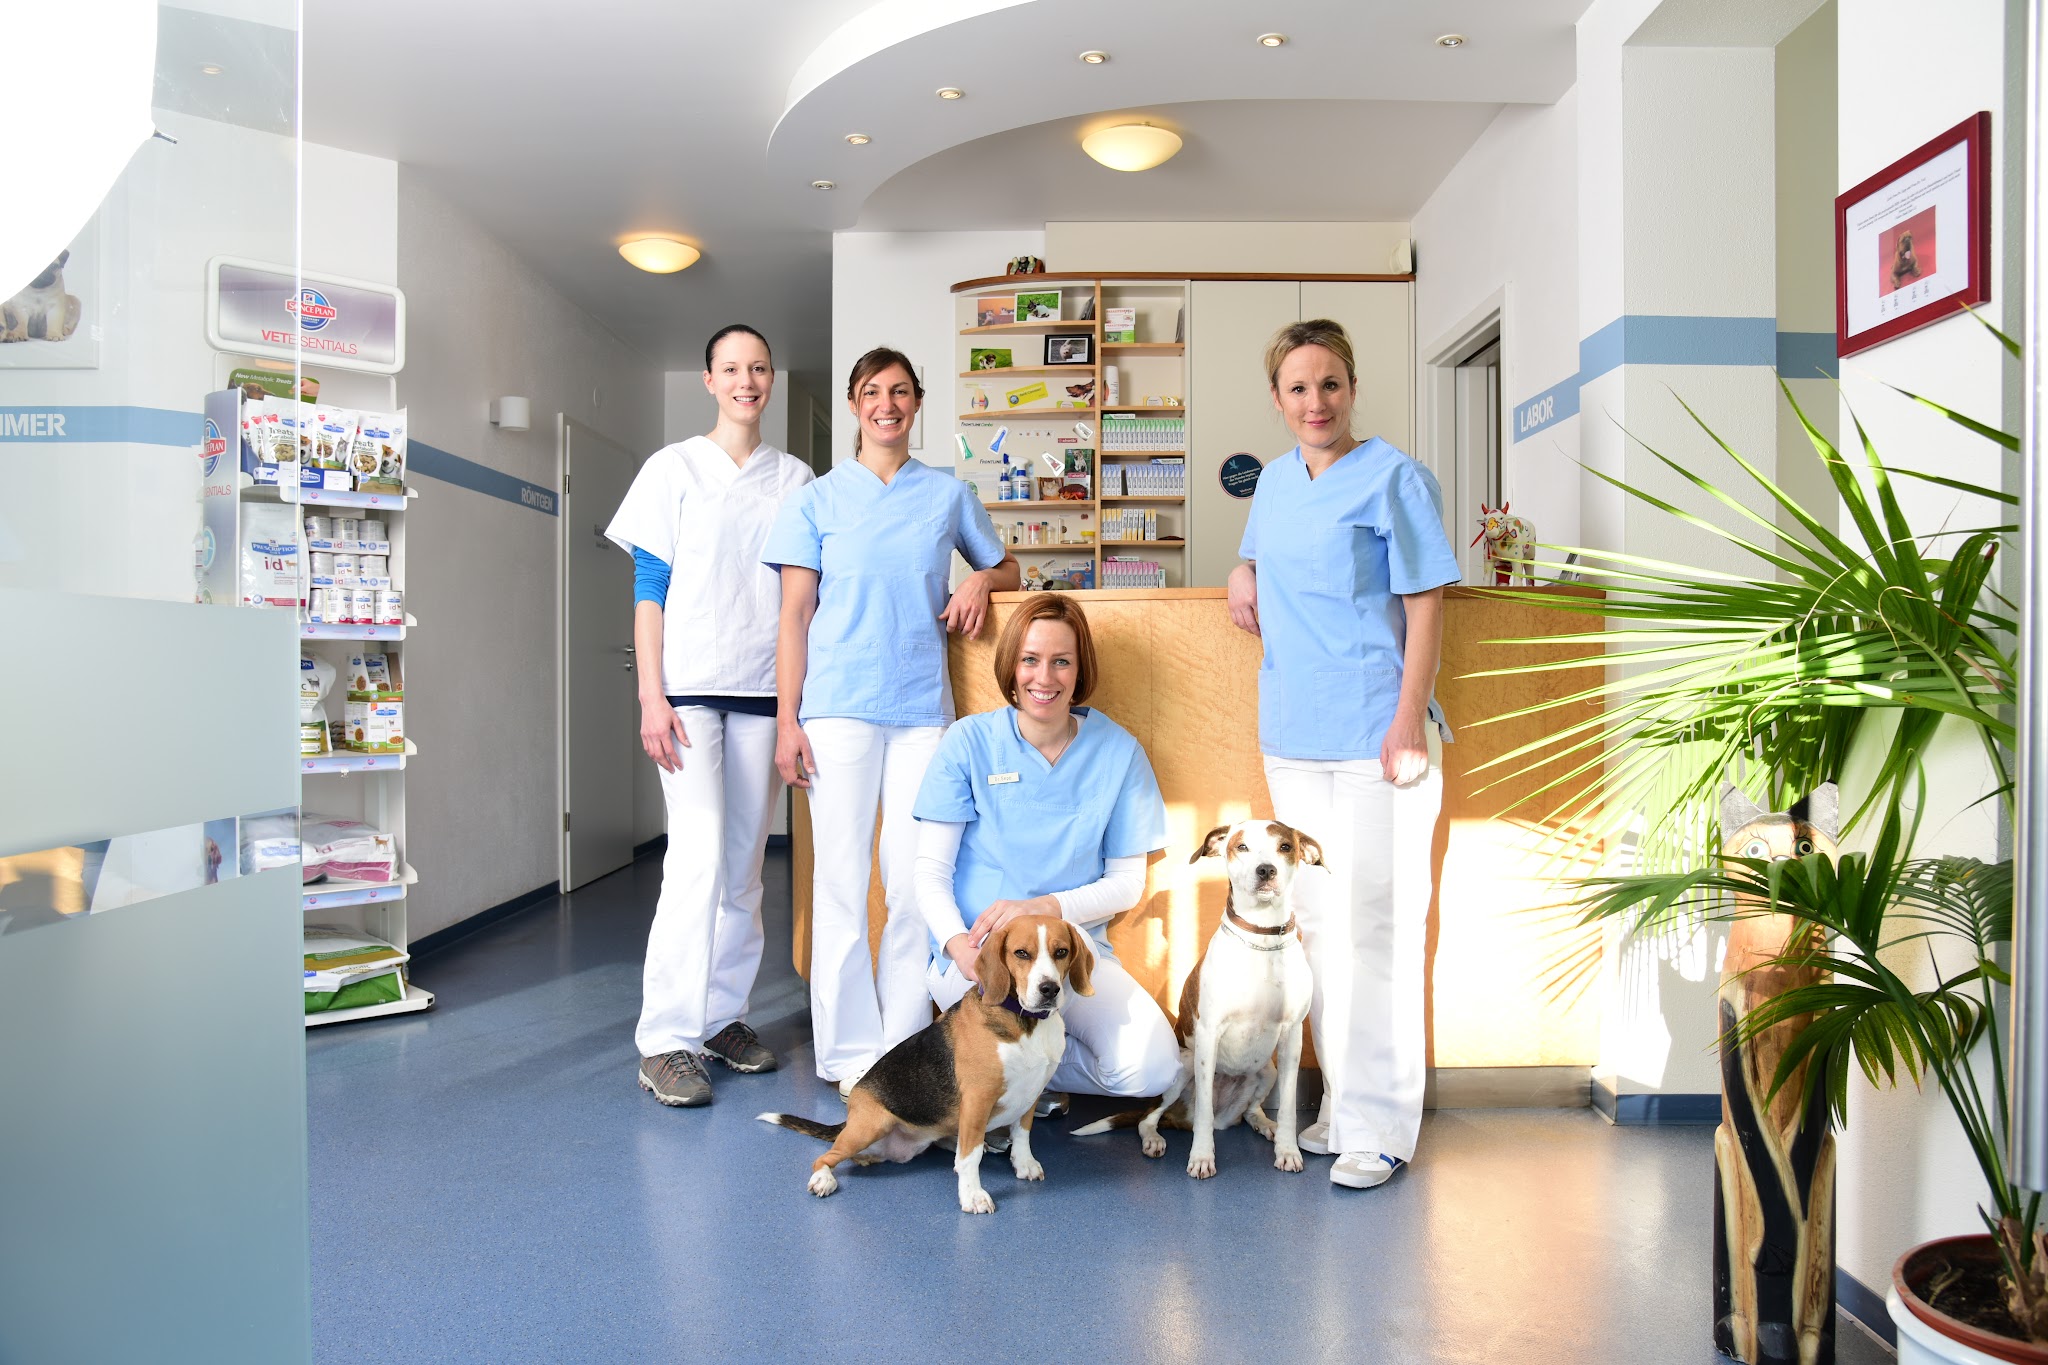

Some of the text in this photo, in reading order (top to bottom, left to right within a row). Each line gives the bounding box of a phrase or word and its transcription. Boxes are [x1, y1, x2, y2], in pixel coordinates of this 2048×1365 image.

[288, 302, 334, 316] SNCE PLAN
[261, 329, 357, 355] VETESENTIALS
[1521, 396, 1554, 432] LABOR
[268, 427, 294, 436] Treats
[521, 486, 553, 511] RÖNTGEN
[264, 556, 283, 571] i/d
